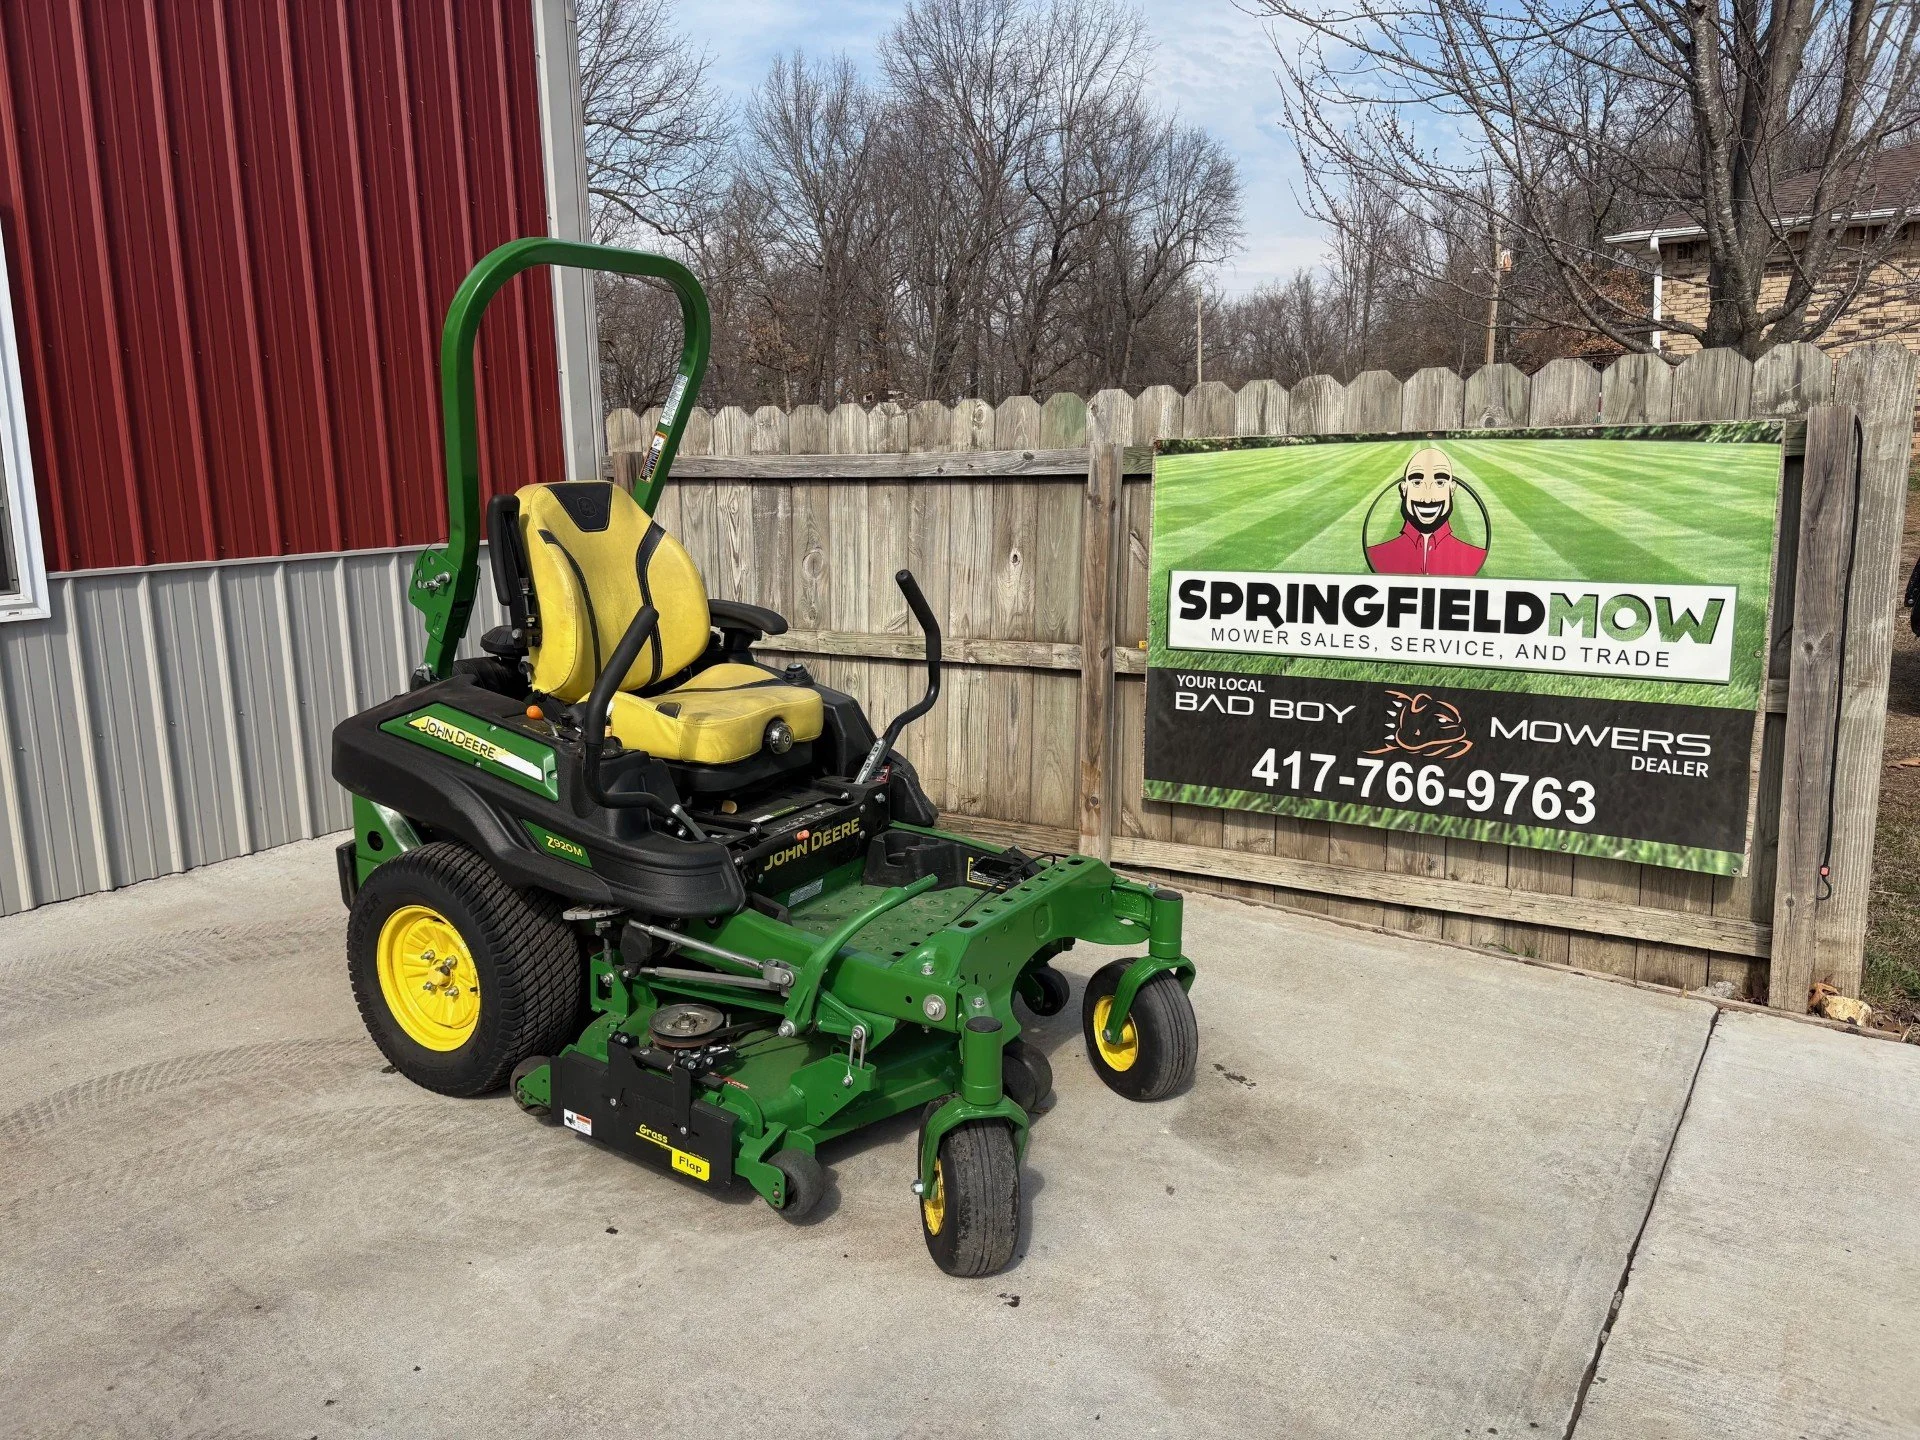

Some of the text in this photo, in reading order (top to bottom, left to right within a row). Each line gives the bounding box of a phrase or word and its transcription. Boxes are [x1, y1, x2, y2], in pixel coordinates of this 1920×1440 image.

[1178, 578, 1726, 645] SPRINGFIELDMOW
[1210, 627, 1670, 668] MOWER SALES, SERVICE, AND TRADE
[1176, 674, 1265, 693] YOUR LOCAL
[420, 718, 497, 760] JOHN DEERE
[1175, 691, 1712, 757] BAD BOY MOWERS
[1251, 747, 1597, 825] 417-766-9763
[1631, 755, 1709, 778] DEALER
[545, 835, 583, 858] Z920M
[763, 839, 808, 871] JOHN
[811, 818, 860, 851] DEERE
[639, 1123, 668, 1144] Grass
[678, 1155, 702, 1174] Flap
